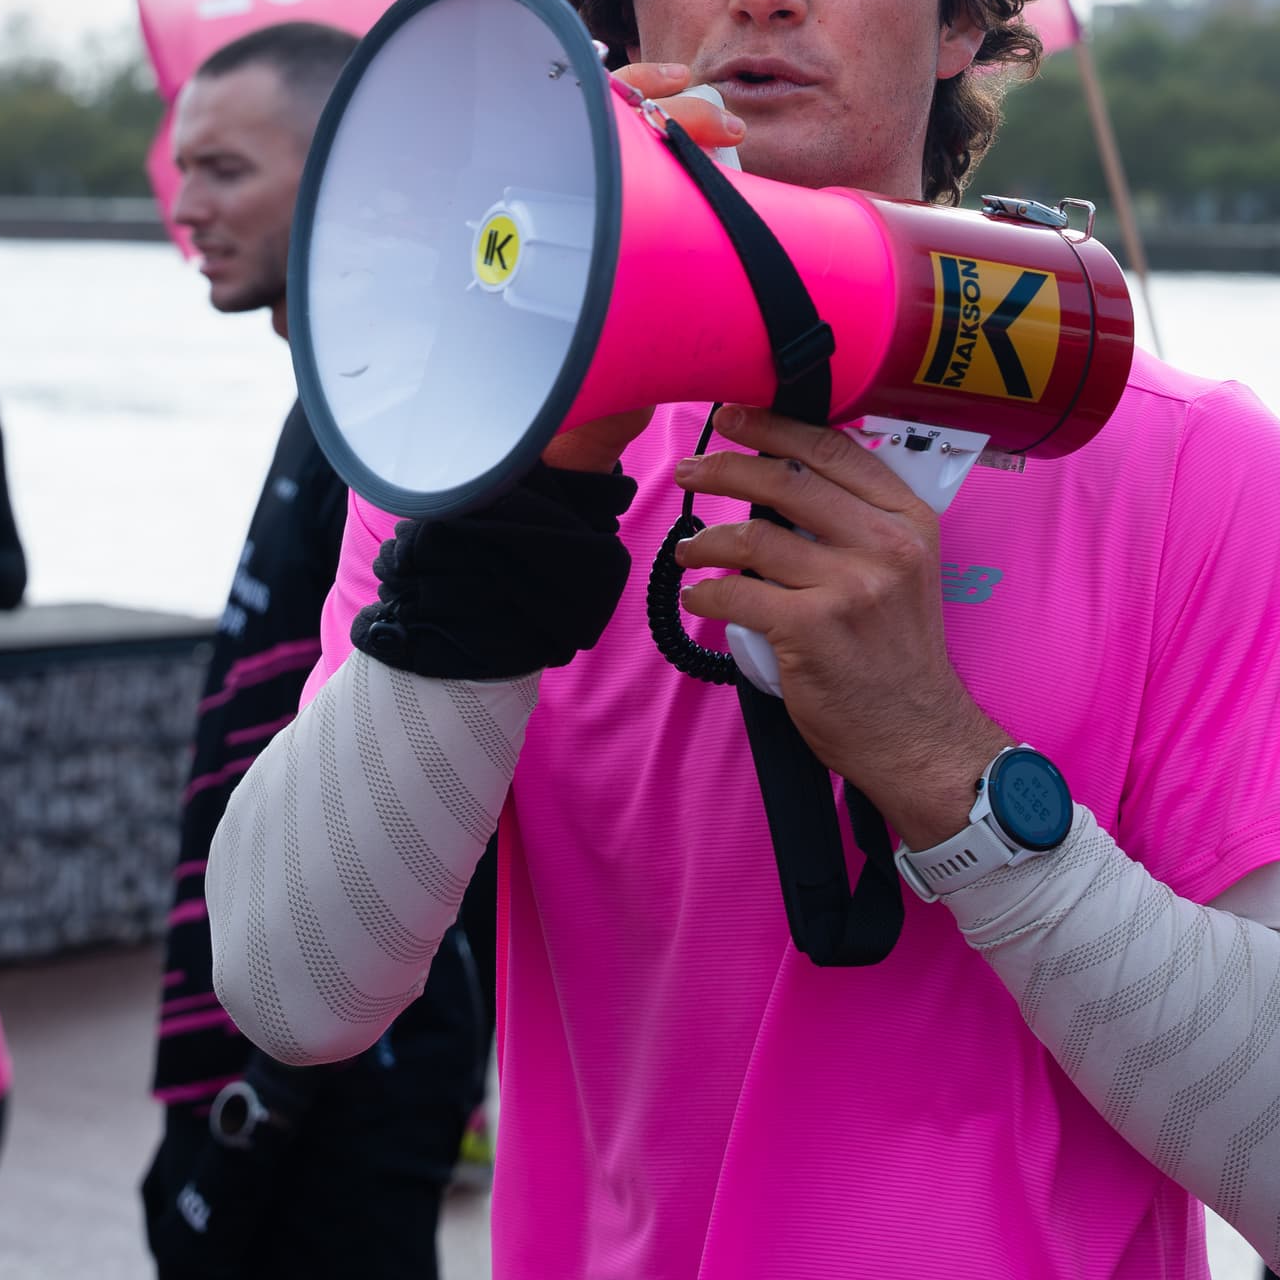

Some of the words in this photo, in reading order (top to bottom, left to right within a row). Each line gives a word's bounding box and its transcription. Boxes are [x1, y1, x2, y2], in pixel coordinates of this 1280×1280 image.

[946, 258, 981, 388] MAKSON
[905, 426, 917, 435] ON
[927, 430, 942, 439] OFF
